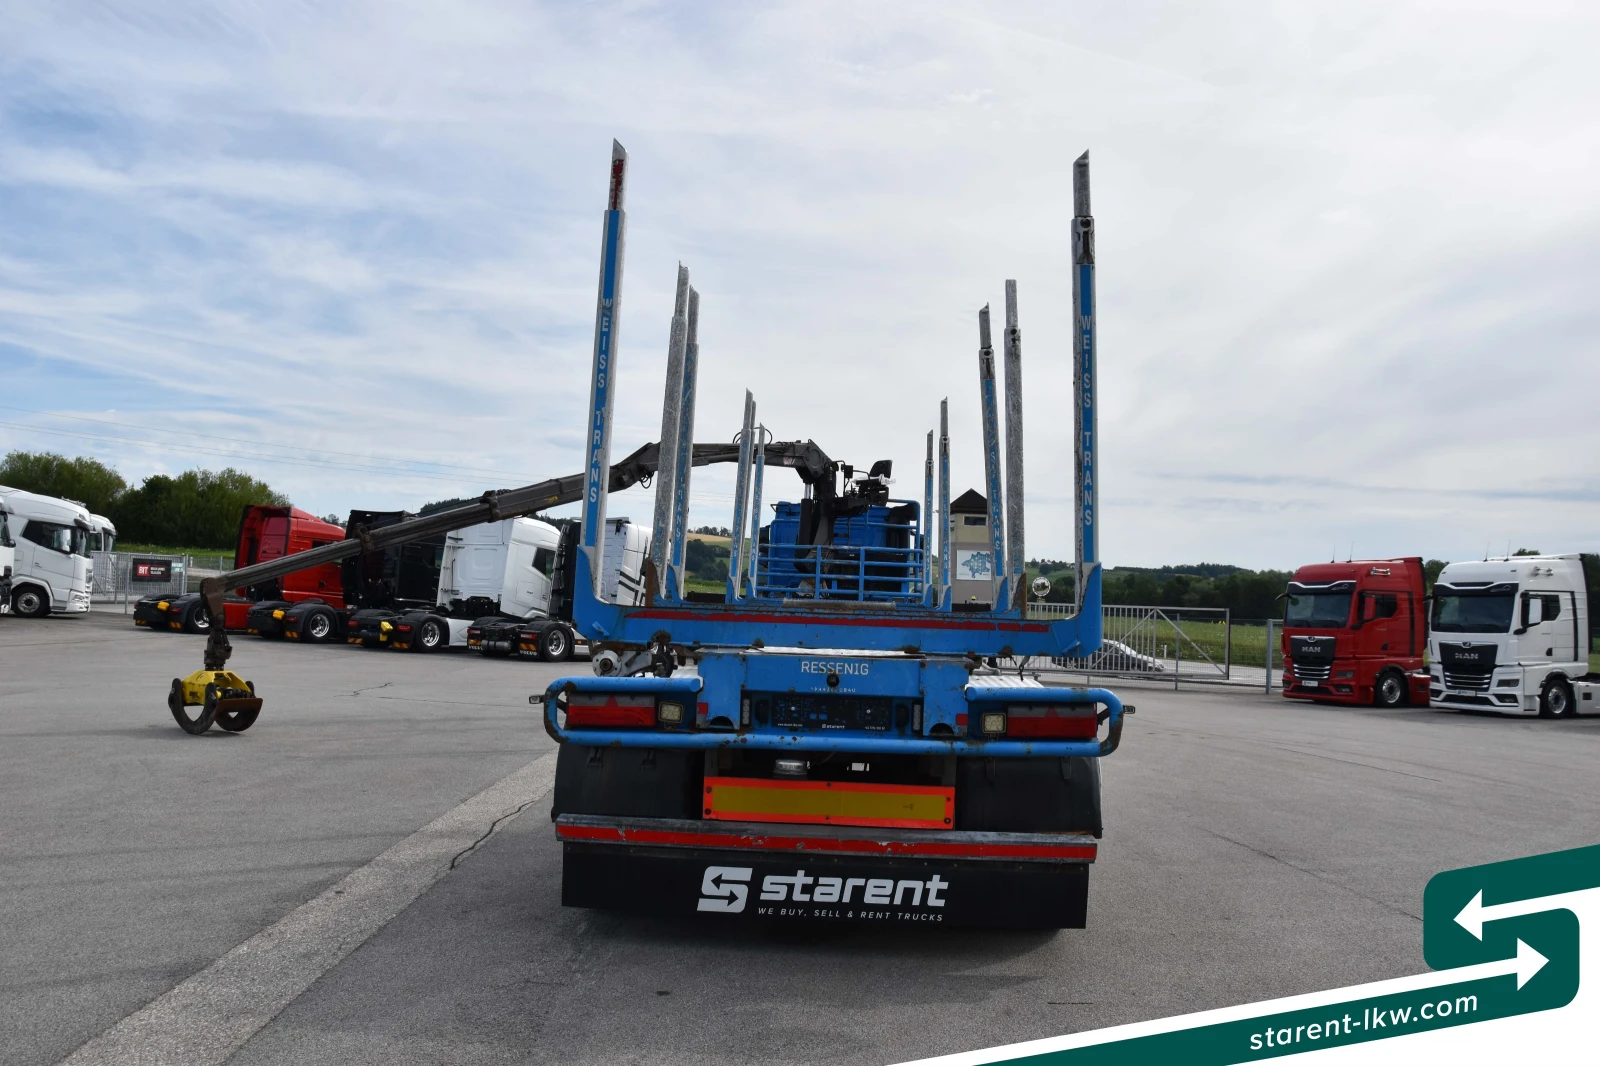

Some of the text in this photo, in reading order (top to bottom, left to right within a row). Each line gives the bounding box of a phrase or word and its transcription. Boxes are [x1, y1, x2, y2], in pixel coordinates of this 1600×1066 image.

[588, 298, 612, 503] WEISS TRANS
[1081, 315, 1094, 526] WEISS TRANS
[801, 661, 869, 675] RESSENIG
[759, 870, 949, 907] starent
[758, 907, 774, 915] WE
[780, 908, 807, 917] BUY,
[814, 909, 841, 918] SELL
[860, 911, 891, 920] RENT
[897, 912, 943, 922] TRUCKS
